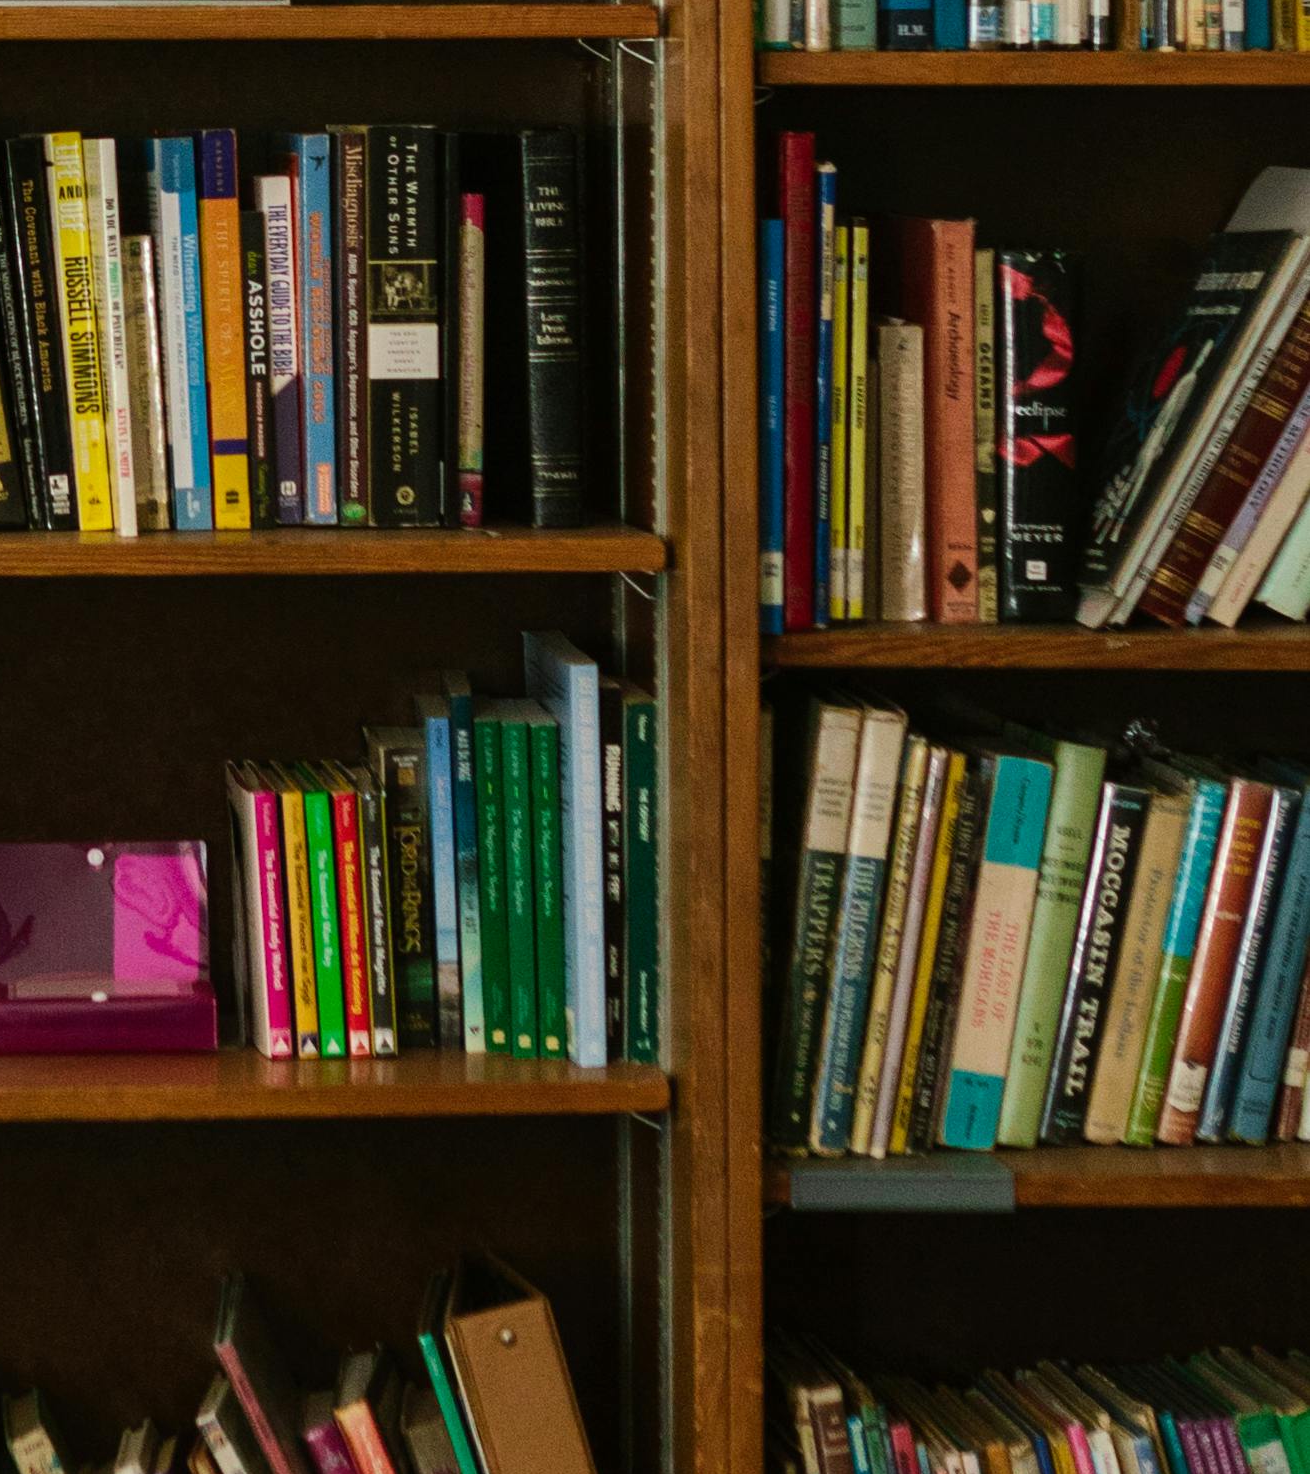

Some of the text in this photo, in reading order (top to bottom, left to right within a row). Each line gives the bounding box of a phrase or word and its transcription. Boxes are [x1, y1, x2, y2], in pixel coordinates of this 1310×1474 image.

[344, 145, 364, 248] Misdiagnosis
[247, 279, 267, 377] ASSHOLE
[1015, 401, 1069, 431] eclipse
[1013, 531, 1064, 545] MEYER
[1064, 824, 1132, 1100] MOCCASIN TRAIL
